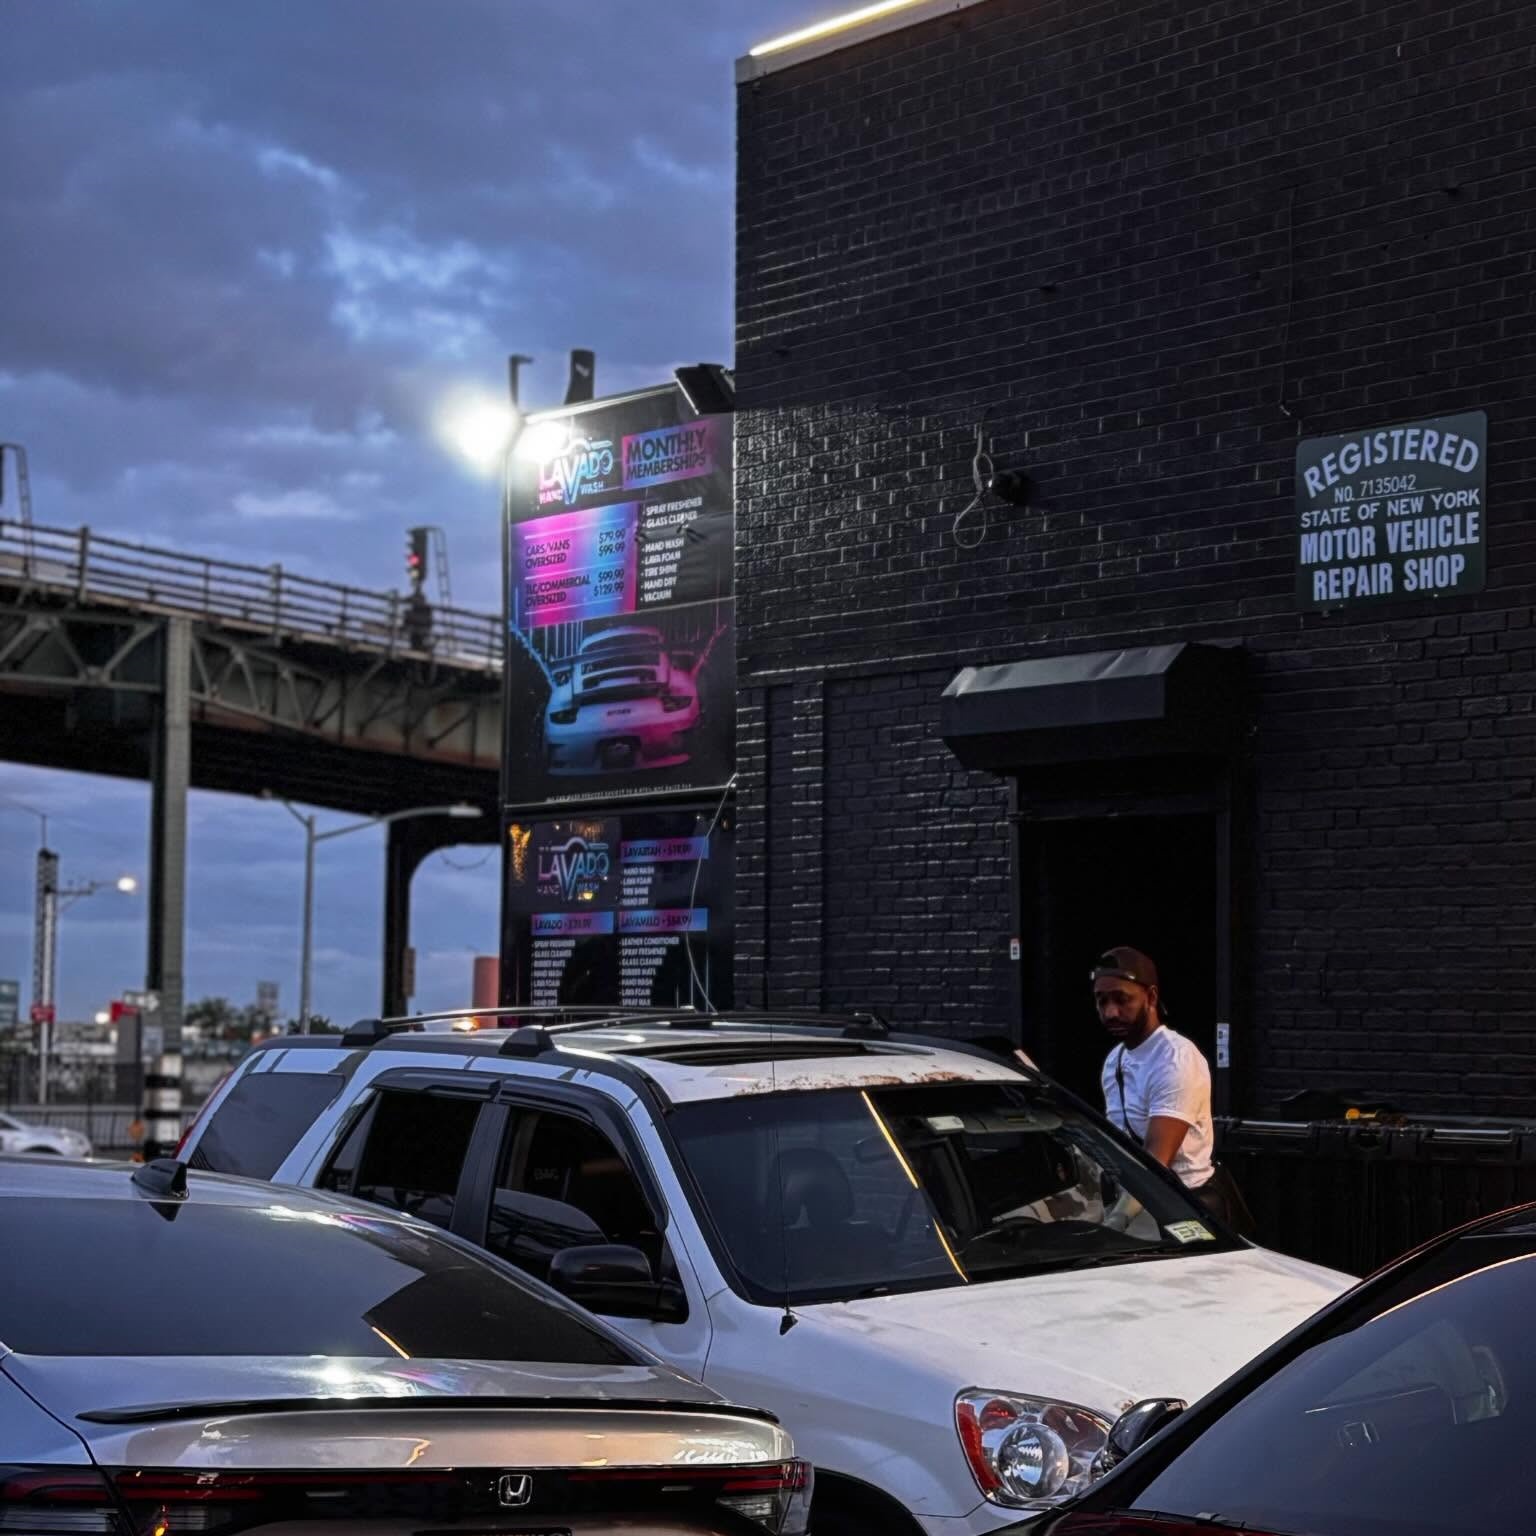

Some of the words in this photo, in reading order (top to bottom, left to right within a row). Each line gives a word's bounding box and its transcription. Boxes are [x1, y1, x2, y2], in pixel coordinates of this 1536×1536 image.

[626, 454, 706, 480] MEMBERSHIPS
[629, 428, 707, 465] MONTHLY
[1304, 428, 1479, 499] REGISTERED
[1300, 507, 1350, 528] STATE
[1358, 502, 1380, 520] OF
[1387, 496, 1424, 517] NEW
[1431, 488, 1480, 511] YORK
[1334, 486, 1355, 503] NO.
[1360, 474, 1417, 497] 7135042
[1300, 526, 1376, 565] MOTOR
[1385, 512, 1480, 554] VEHICLE
[1313, 562, 1393, 601] REPAIR
[1403, 553, 1465, 592] SHOP
[538, 852, 609, 901] LAVADO
